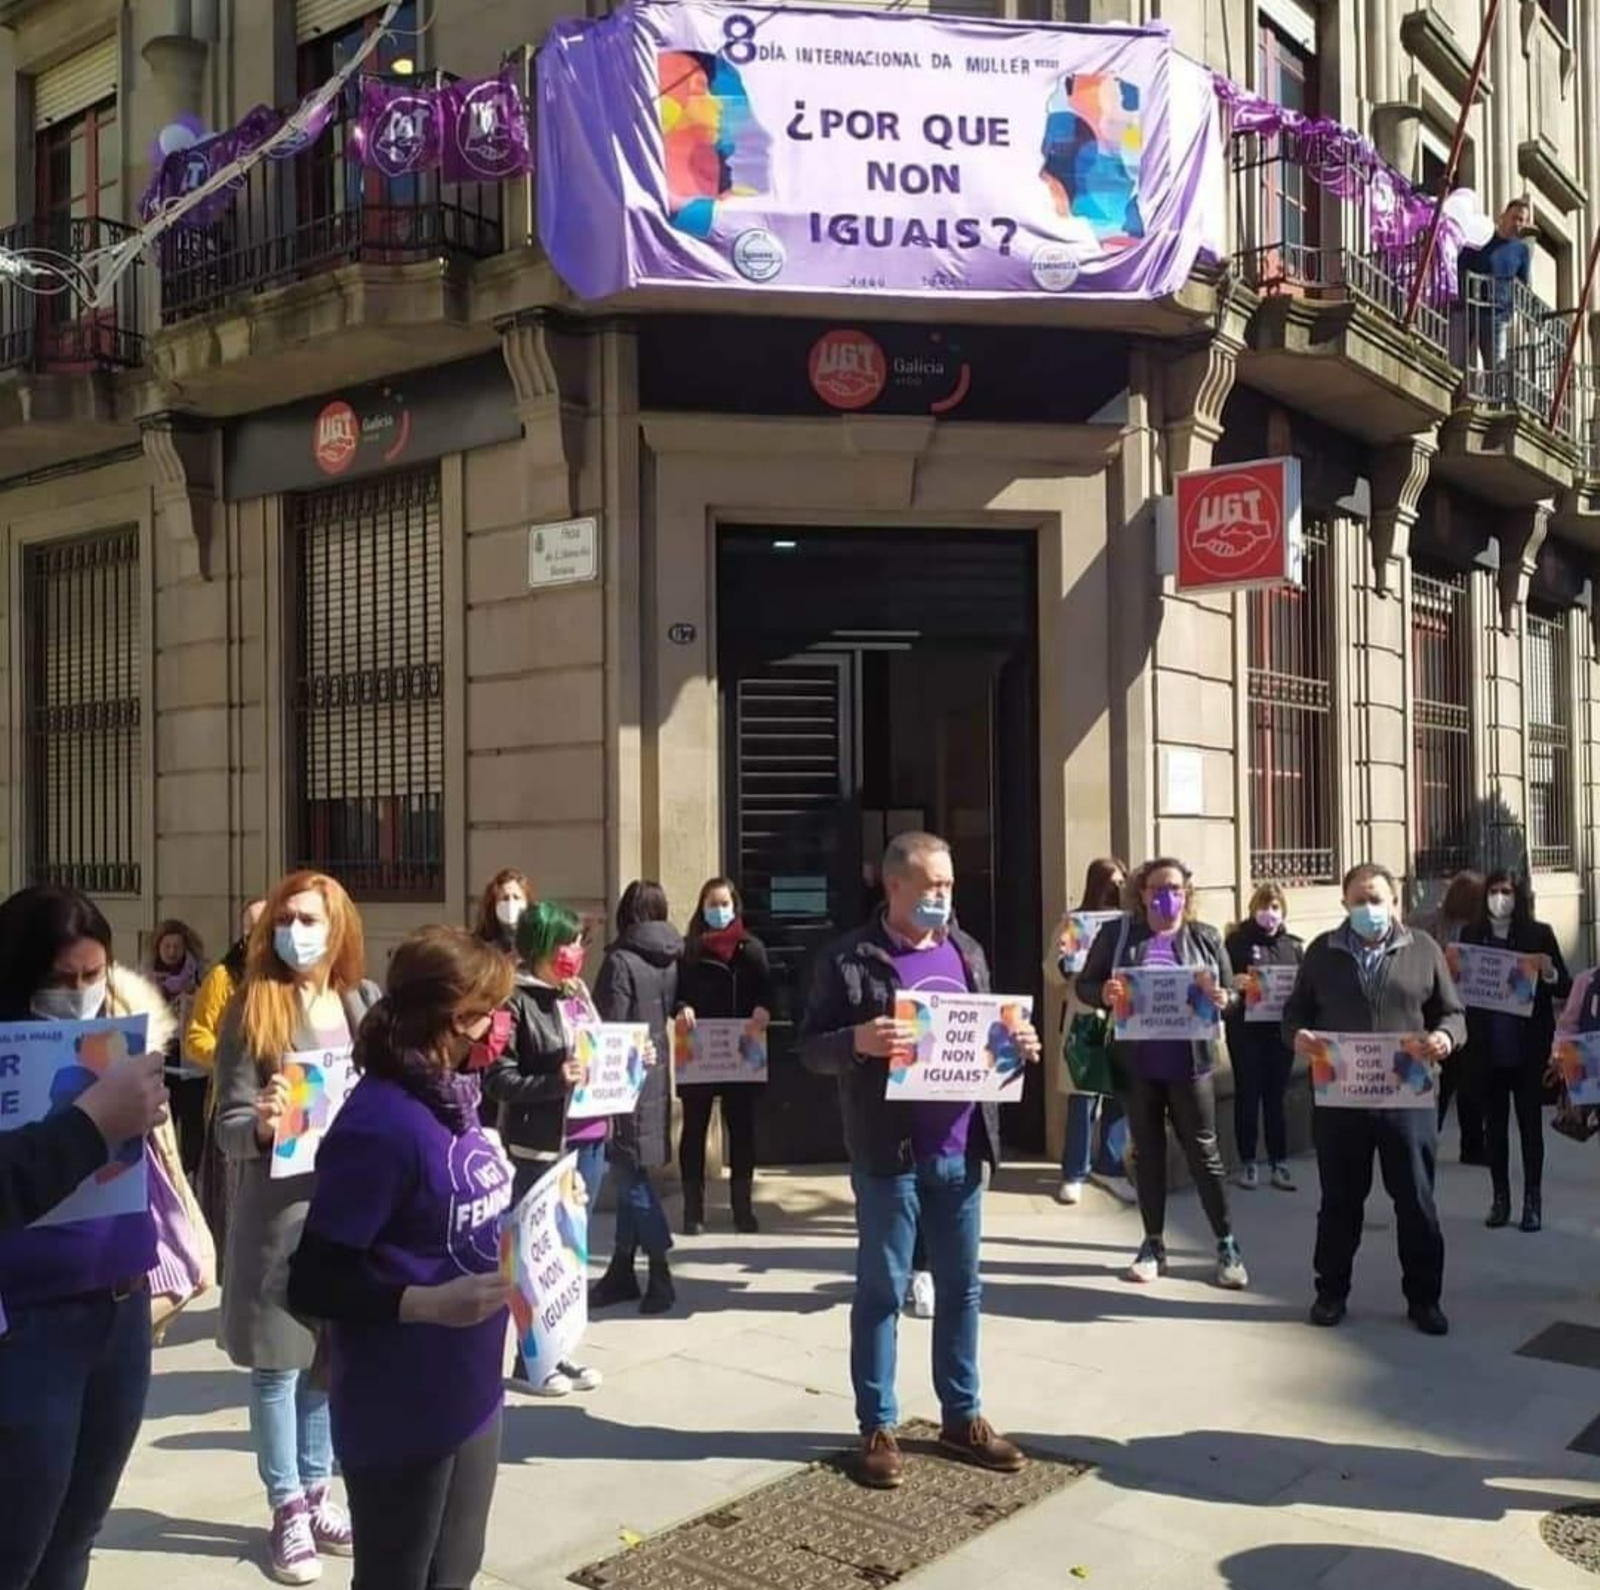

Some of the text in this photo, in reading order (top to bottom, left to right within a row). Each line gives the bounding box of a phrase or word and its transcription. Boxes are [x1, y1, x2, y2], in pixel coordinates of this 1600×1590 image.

[723, 14, 757, 65] 8
[758, 41, 786, 61] DÍA
[796, 47, 921, 68] INTERNACIONAL
[931, 53, 952, 69] DA
[966, 57, 1030, 74] MULLER
[786, 100, 1010, 150] ¿POR QUE
[867, 161, 960, 195] NON
[810, 212, 1018, 256] IGUAIS?
[819, 343, 945, 375] UGT Galicia
[320, 411, 353, 445] UGT
[1198, 489, 1262, 533] UGT
[948, 1010, 979, 1024] POR
[945, 1030, 976, 1045] QUE
[1355, 1044, 1382, 1054] POR
[941, 1049, 976, 1063] NON
[923, 1067, 990, 1083] IGUAIS?
[1356, 1072, 1386, 1082] NON
[530, 1230, 552, 1263] QUE
[538, 1256, 565, 1293] NON
